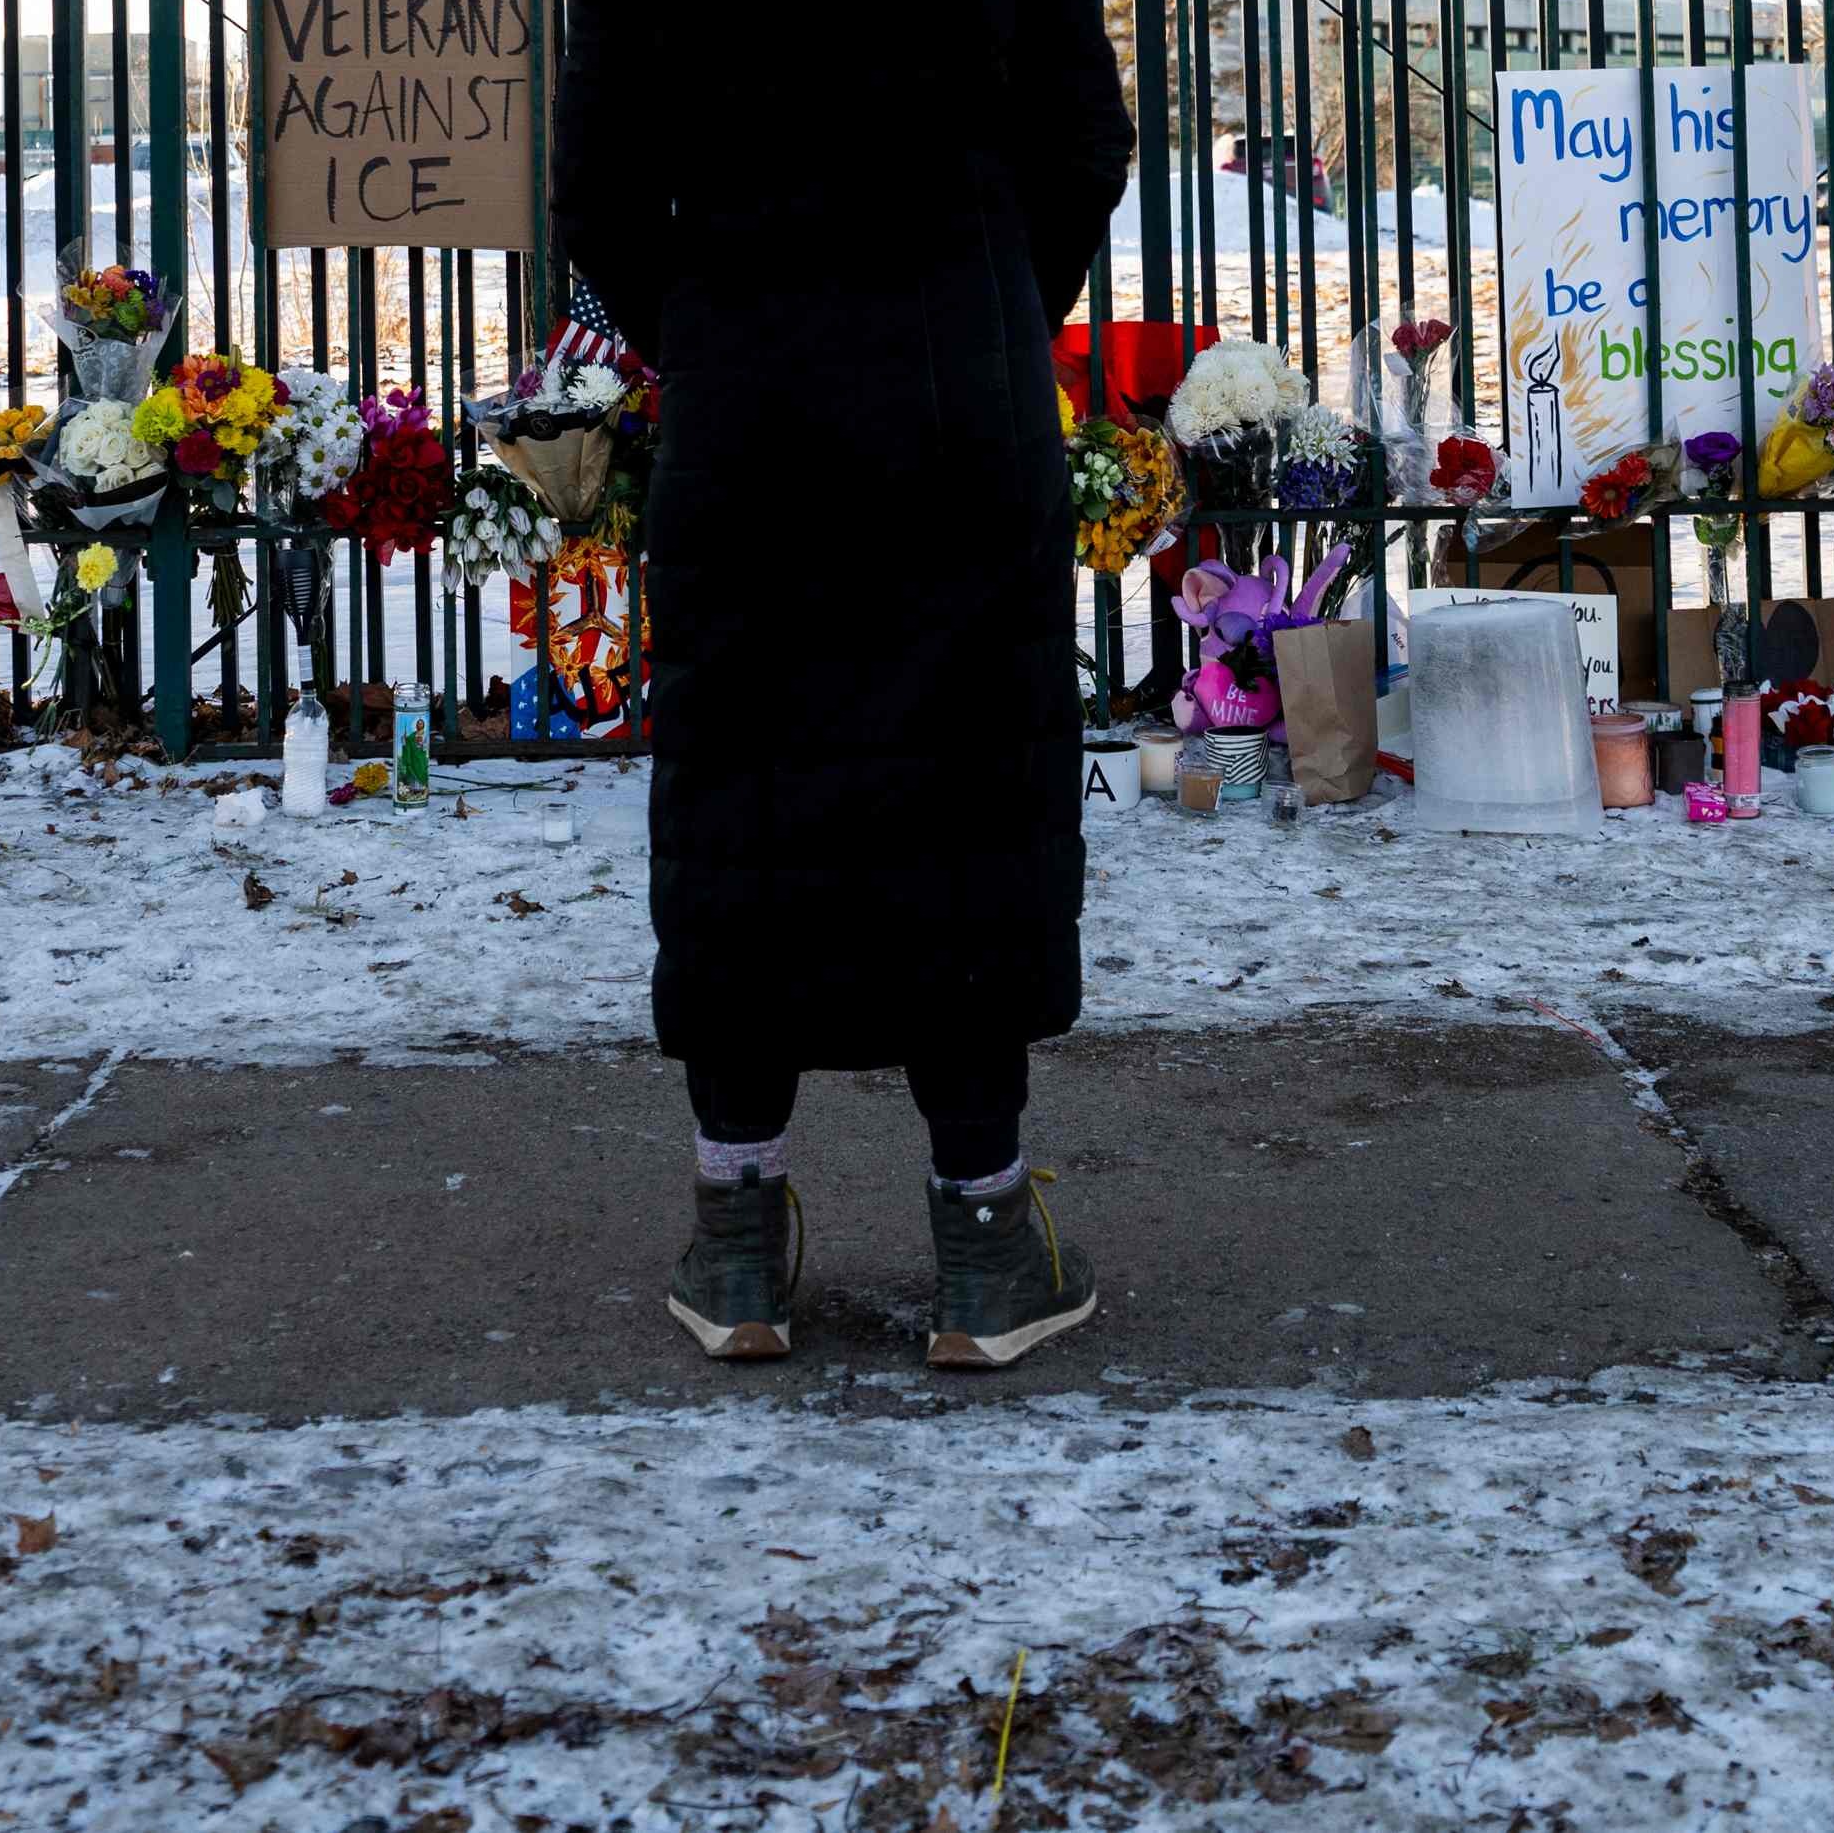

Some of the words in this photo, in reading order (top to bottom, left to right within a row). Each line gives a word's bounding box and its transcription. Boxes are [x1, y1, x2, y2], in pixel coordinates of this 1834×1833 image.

[274, 70, 526, 143] AGAINST
[1511, 88, 1633, 183] May
[326, 156, 466, 224] ICE
[1546, 267, 1607, 317] be
[1211, 699, 1258, 726] MINE
[1226, 683, 1247, 703] BE
